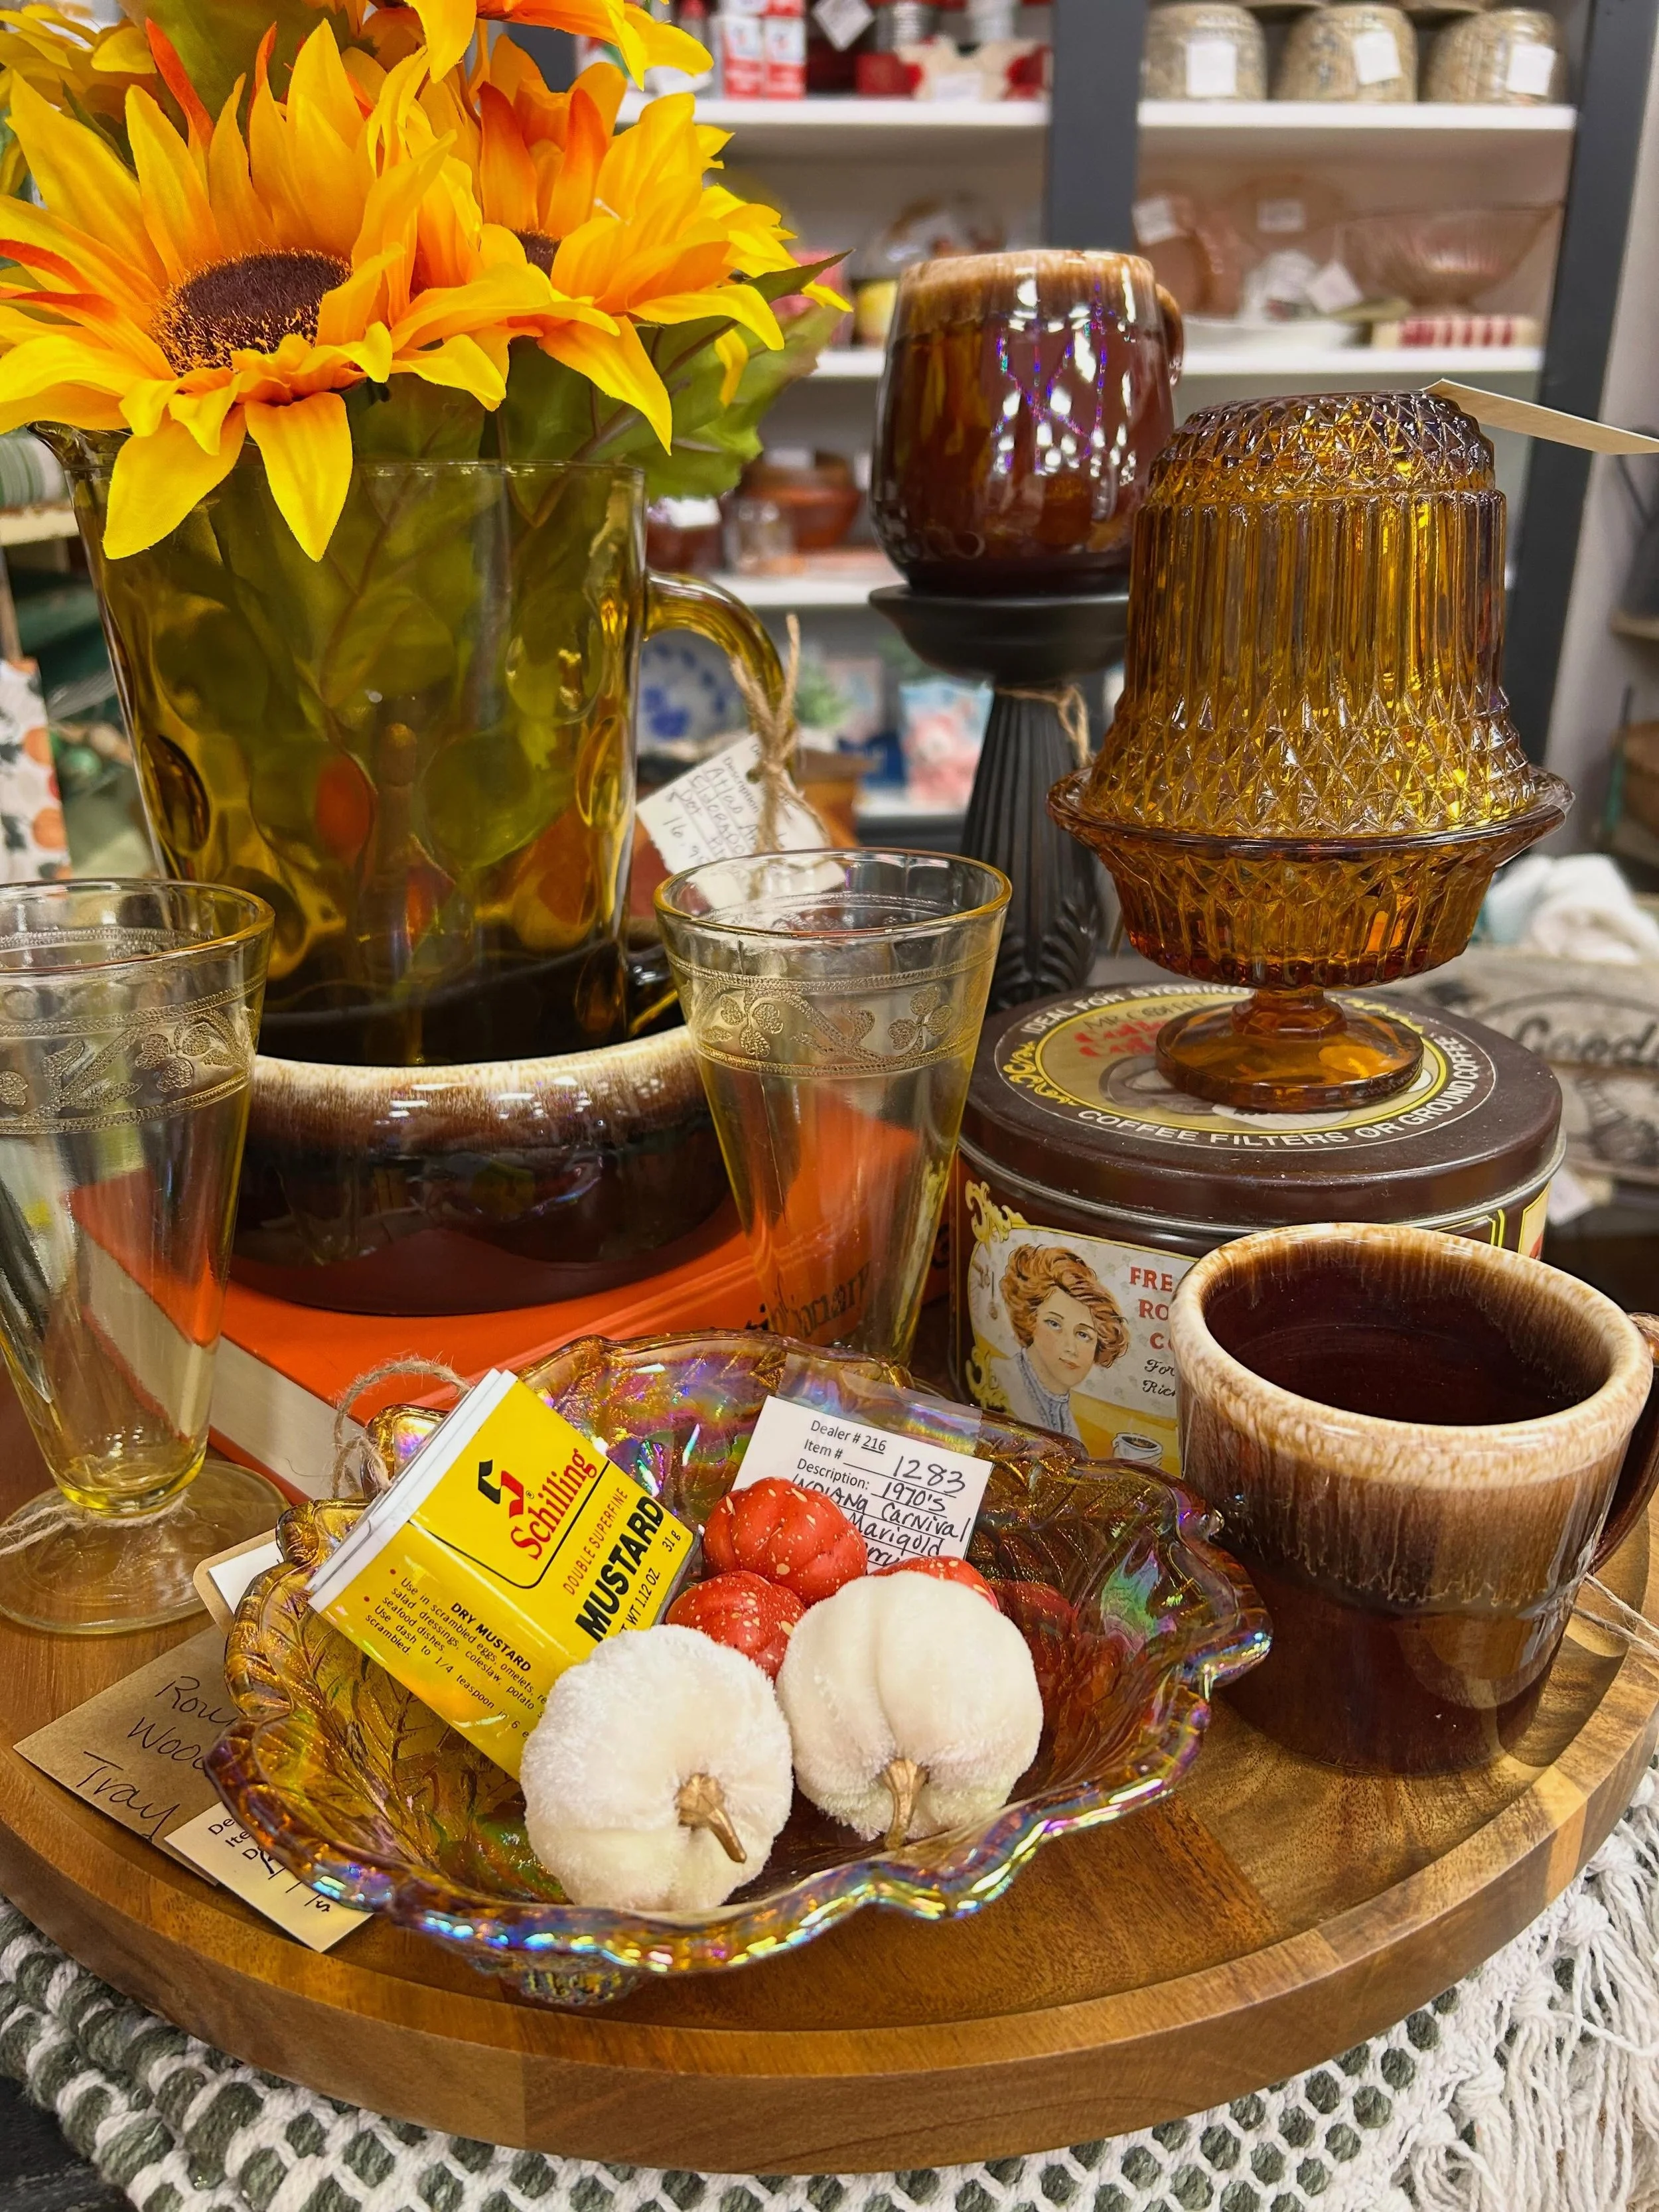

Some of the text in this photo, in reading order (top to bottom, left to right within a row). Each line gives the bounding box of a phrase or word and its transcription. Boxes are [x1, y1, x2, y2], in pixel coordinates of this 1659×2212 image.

[1020, 984, 1250, 1035] IDEAL FOR STORING
[1433, 1034, 1479, 1080] COFFEE
[1078, 1110, 1199, 1141] COFFEE
[1398, 1080, 1476, 1126] GROUND
[1210, 1132, 1349, 1146] FILTERS
[1354, 1122, 1405, 1139] OR
[1129, 1266, 1173, 1292] FRE
[1138, 1299, 1169, 1321] RO
[1142, 1379, 1176, 1397] Ric
[811, 1420, 887, 1453] Dealer # 216
[797, 1458, 870, 1491] Description:
[804, 1438, 965, 1493] Item # 1283
[510, 1448, 597, 1560] Schilling
[563, 1487, 628, 1595] DOUBLE SUPERFINE
[575, 1496, 664, 1643] MUSTARD
[626, 1605, 641, 1626] WT
[638, 1584, 652, 1608] 1.12
[646, 1567, 661, 1586] OZ
[662, 1538, 675, 1552] 31
[365, 1614, 411, 1656] scrambled.
[382, 1597, 445, 1653] seafood dishes.
[392, 1587, 535, 1710] salad dressings, coleslaw, potato
[401, 1577, 418, 1595] Use
[419, 1593, 430, 1605] in
[431, 1604, 477, 1643] scrambled
[476, 1643, 497, 1664] eggs,
[500, 1662, 534, 1695] omelets,
[451, 1602, 532, 1672] DRY MUSTARD
[374, 1605, 392, 1622] Use
[396, 1624, 417, 1645] dash
[421, 1645, 431, 1655] to
[435, 1657, 454, 1673] 1/4
[456, 1674, 494, 1709] teaspoon
[511, 1720, 520, 1729] 6
[75, 1750, 181, 1844] Tray
[226, 1830, 250, 1848] Ite
